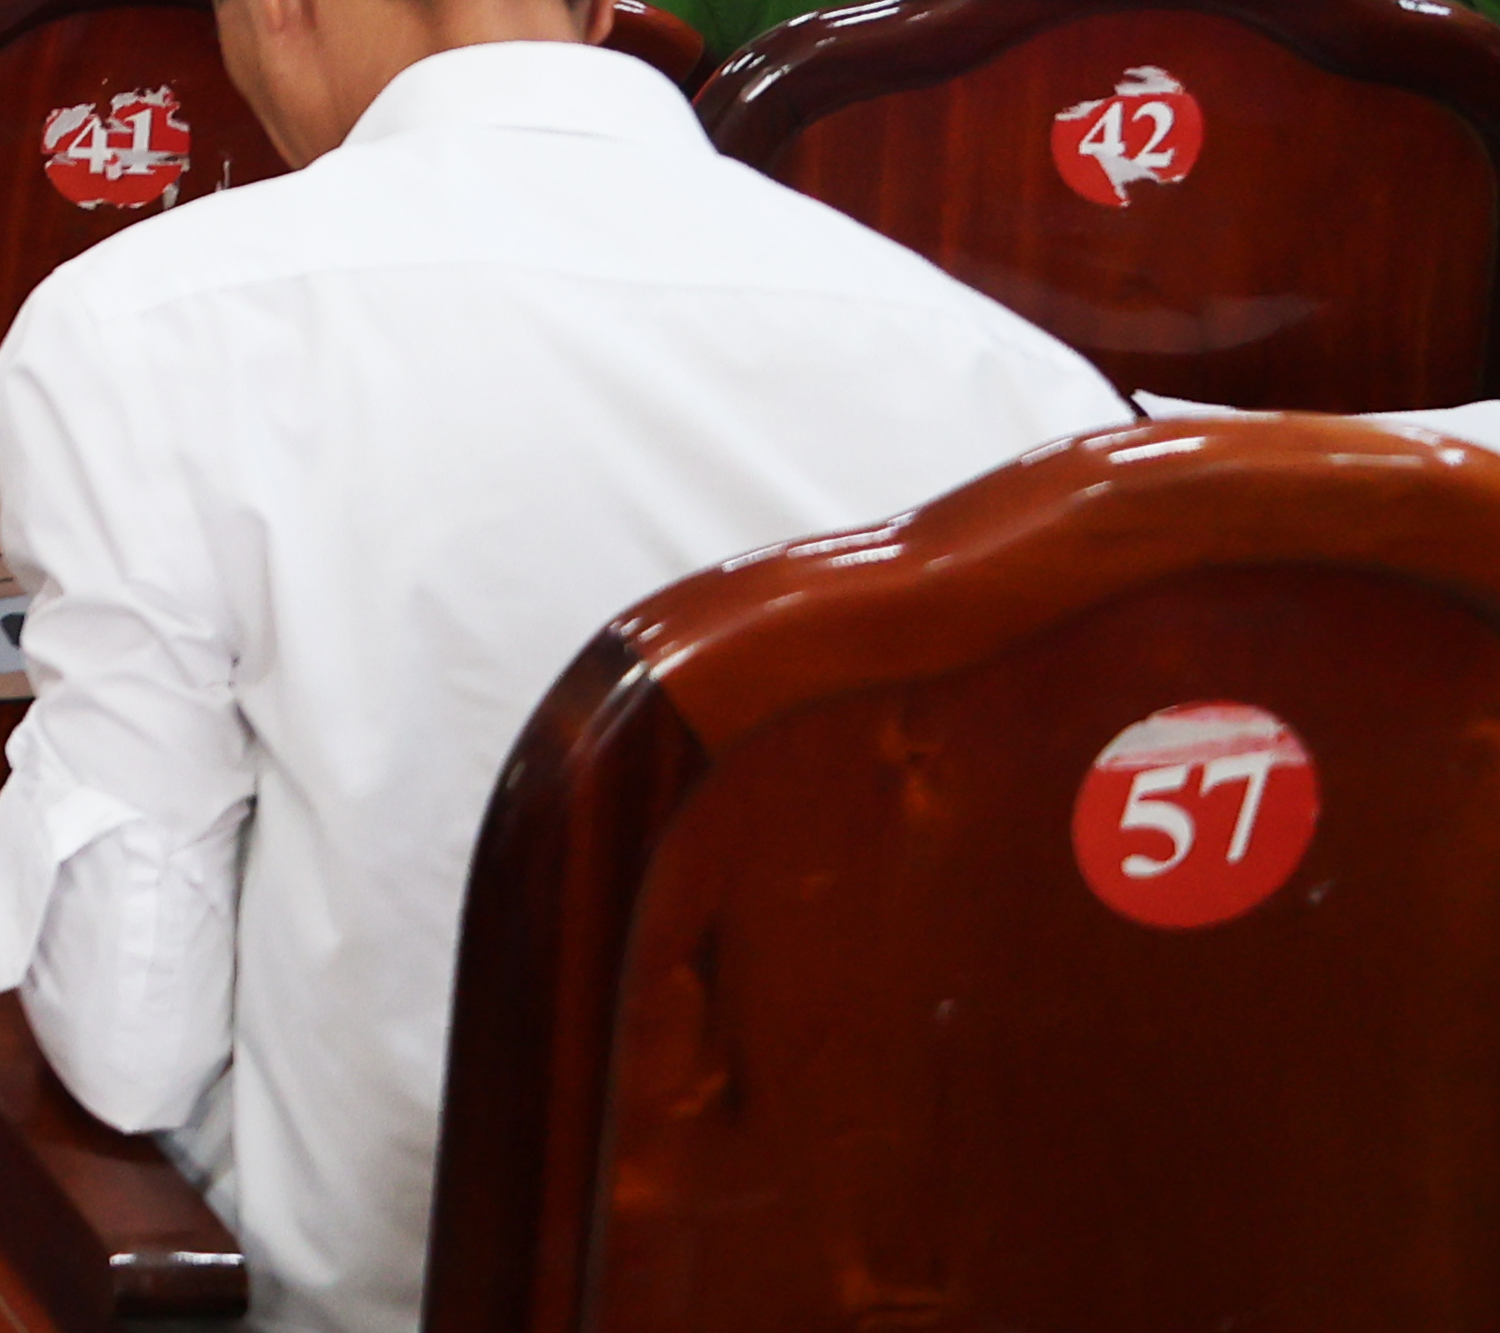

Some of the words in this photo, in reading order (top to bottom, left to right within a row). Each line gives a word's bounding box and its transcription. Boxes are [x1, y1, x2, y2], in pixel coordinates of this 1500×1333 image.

[68, 108, 155, 175] 41
[1078, 101, 1175, 168] 42
[1118, 753, 1275, 880] 57
